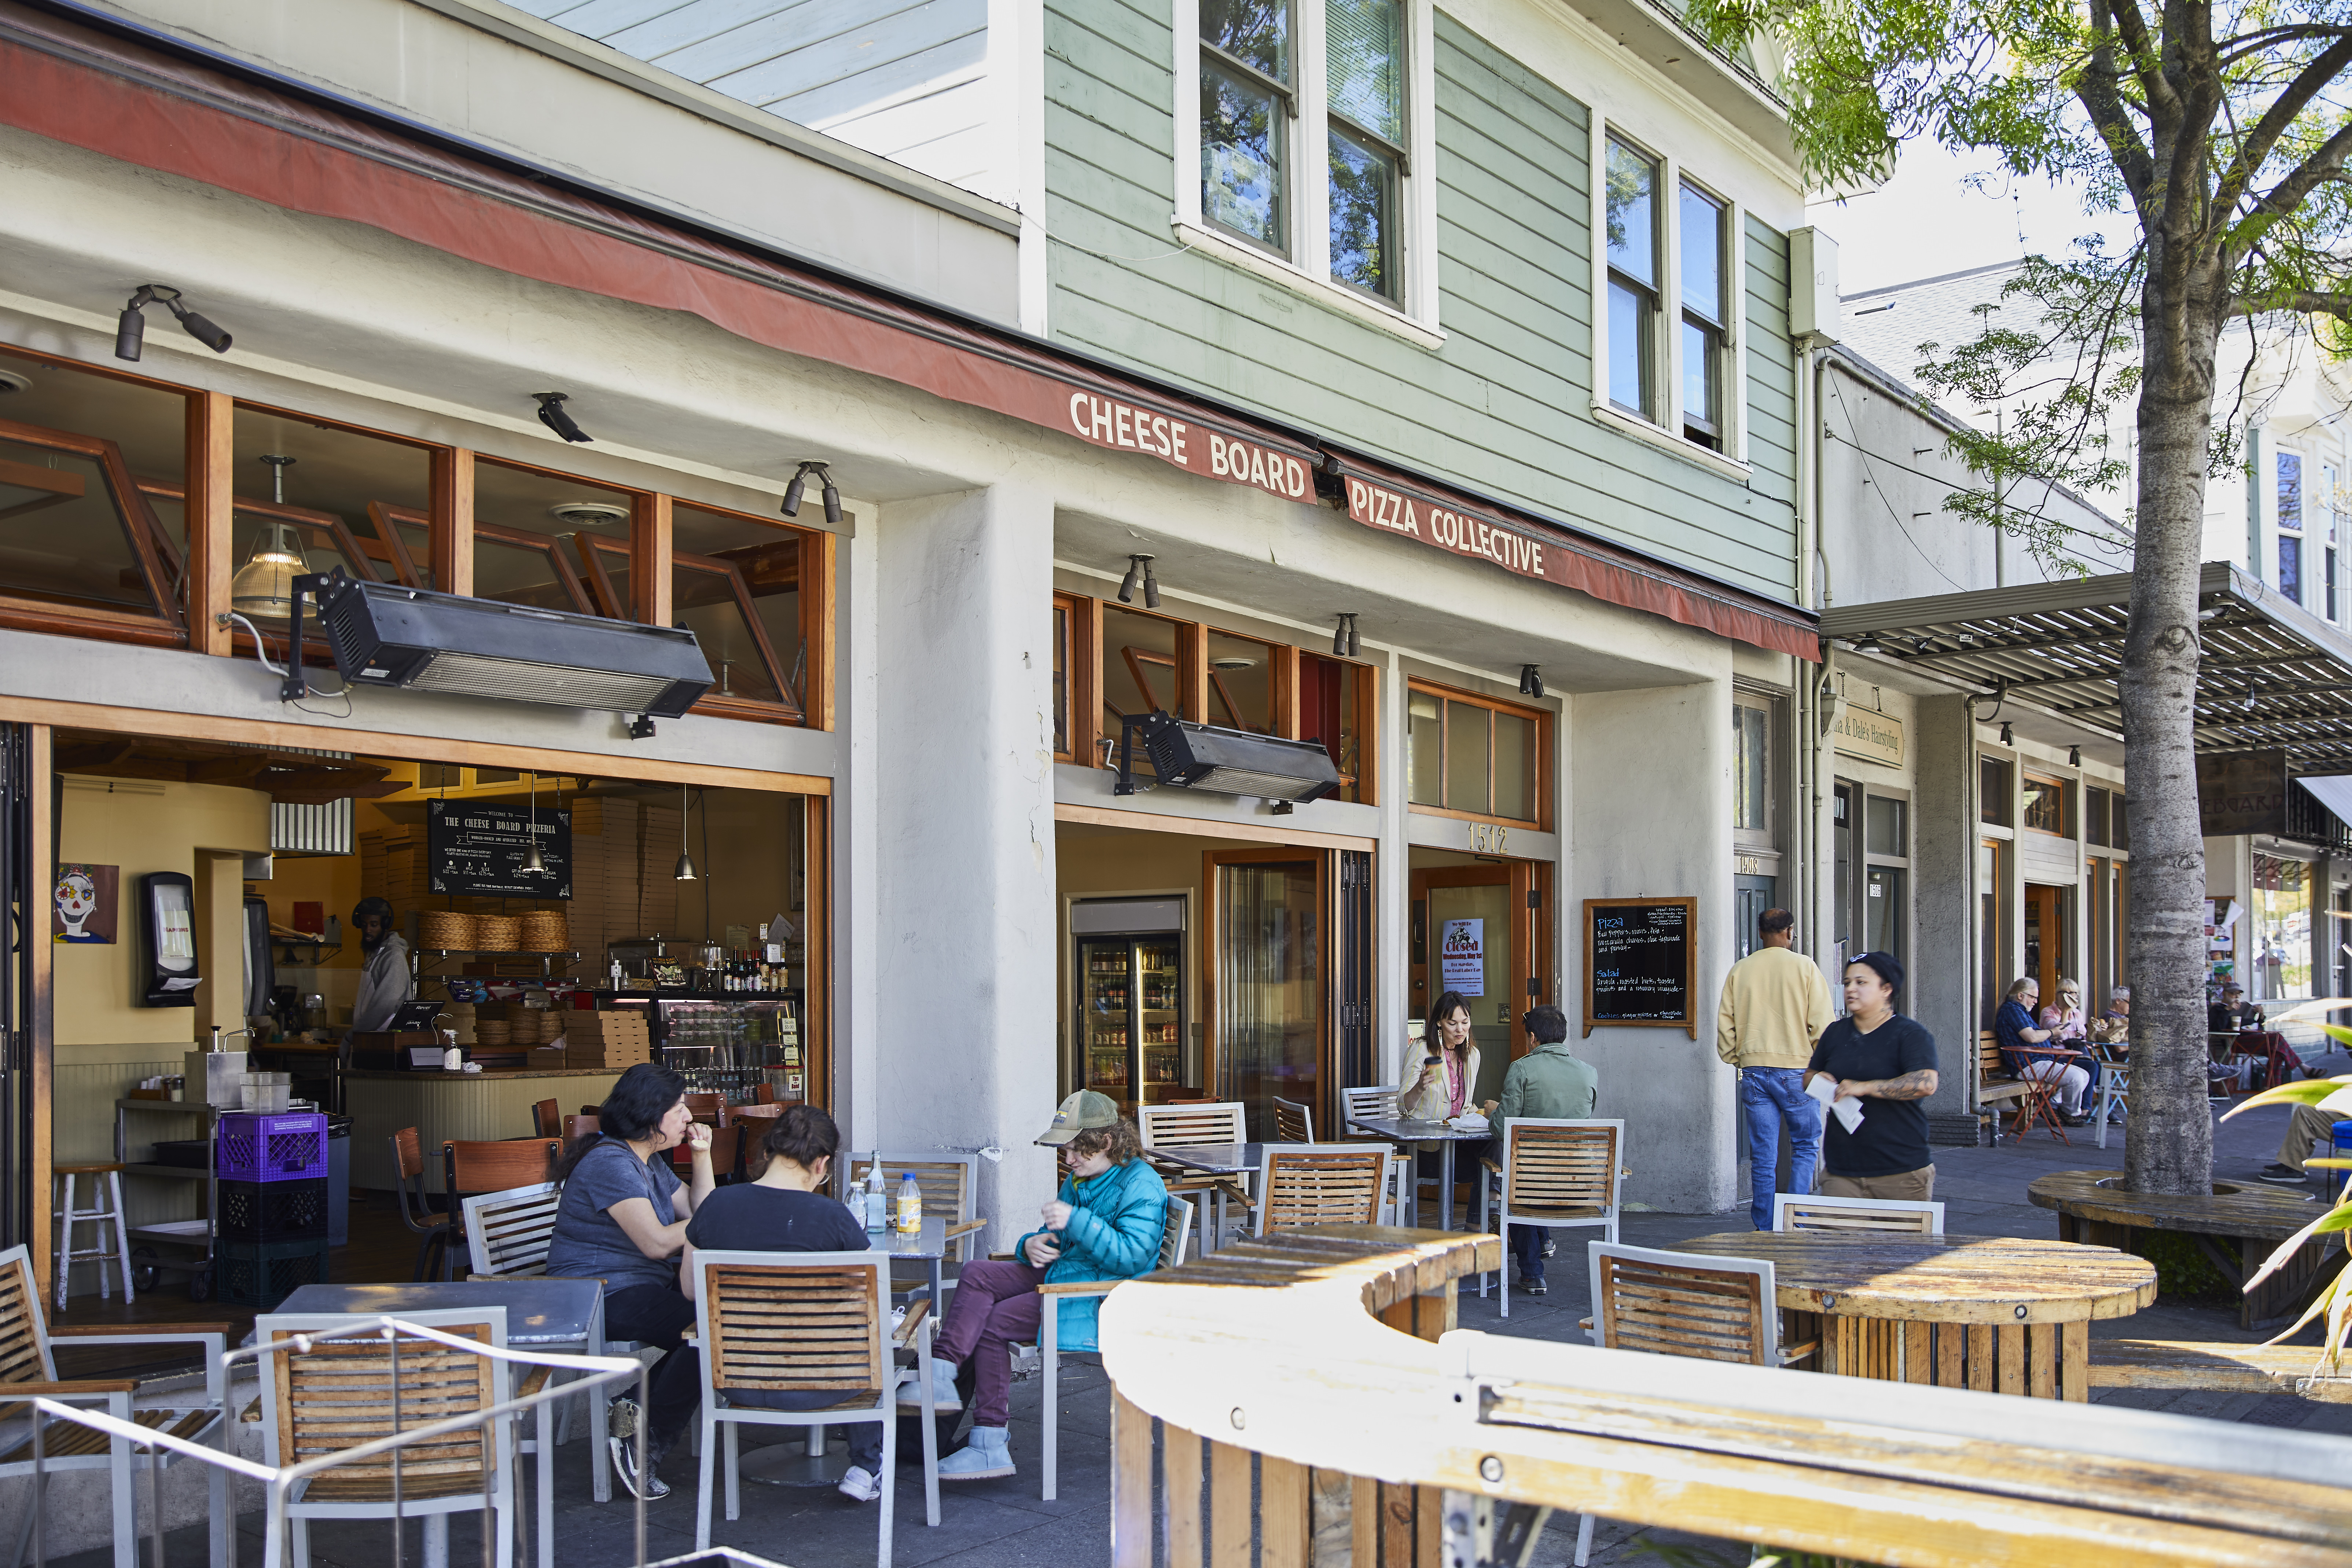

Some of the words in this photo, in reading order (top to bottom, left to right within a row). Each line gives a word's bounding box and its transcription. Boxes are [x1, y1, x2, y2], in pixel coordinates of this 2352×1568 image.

[1070, 393, 1187, 464] CHEESE
[1210, 434, 1305, 497] BOARD
[1352, 481, 1419, 536] PIZZA
[1431, 509, 1544, 575] COLLECTIVE
[1845, 716, 1851, 736] &
[1853, 719, 1869, 741] Dale's
[1871, 724, 1897, 755] Hairstyling
[2201, 794, 2283, 814] EBOARD
[445, 817, 459, 826] THE
[465, 819, 489, 829] CHEESE
[496, 821, 520, 831] BOARD
[526, 823, 556, 834] PIZZERIA
[1469, 822, 1507, 854] 1512
[1740, 856, 1757, 874] 1508
[1871, 885, 1880, 896] 1506
[1598, 918, 1624, 929] Pizza
[1446, 941, 1478, 952] Closed
[1597, 968, 1619, 977] Salad
